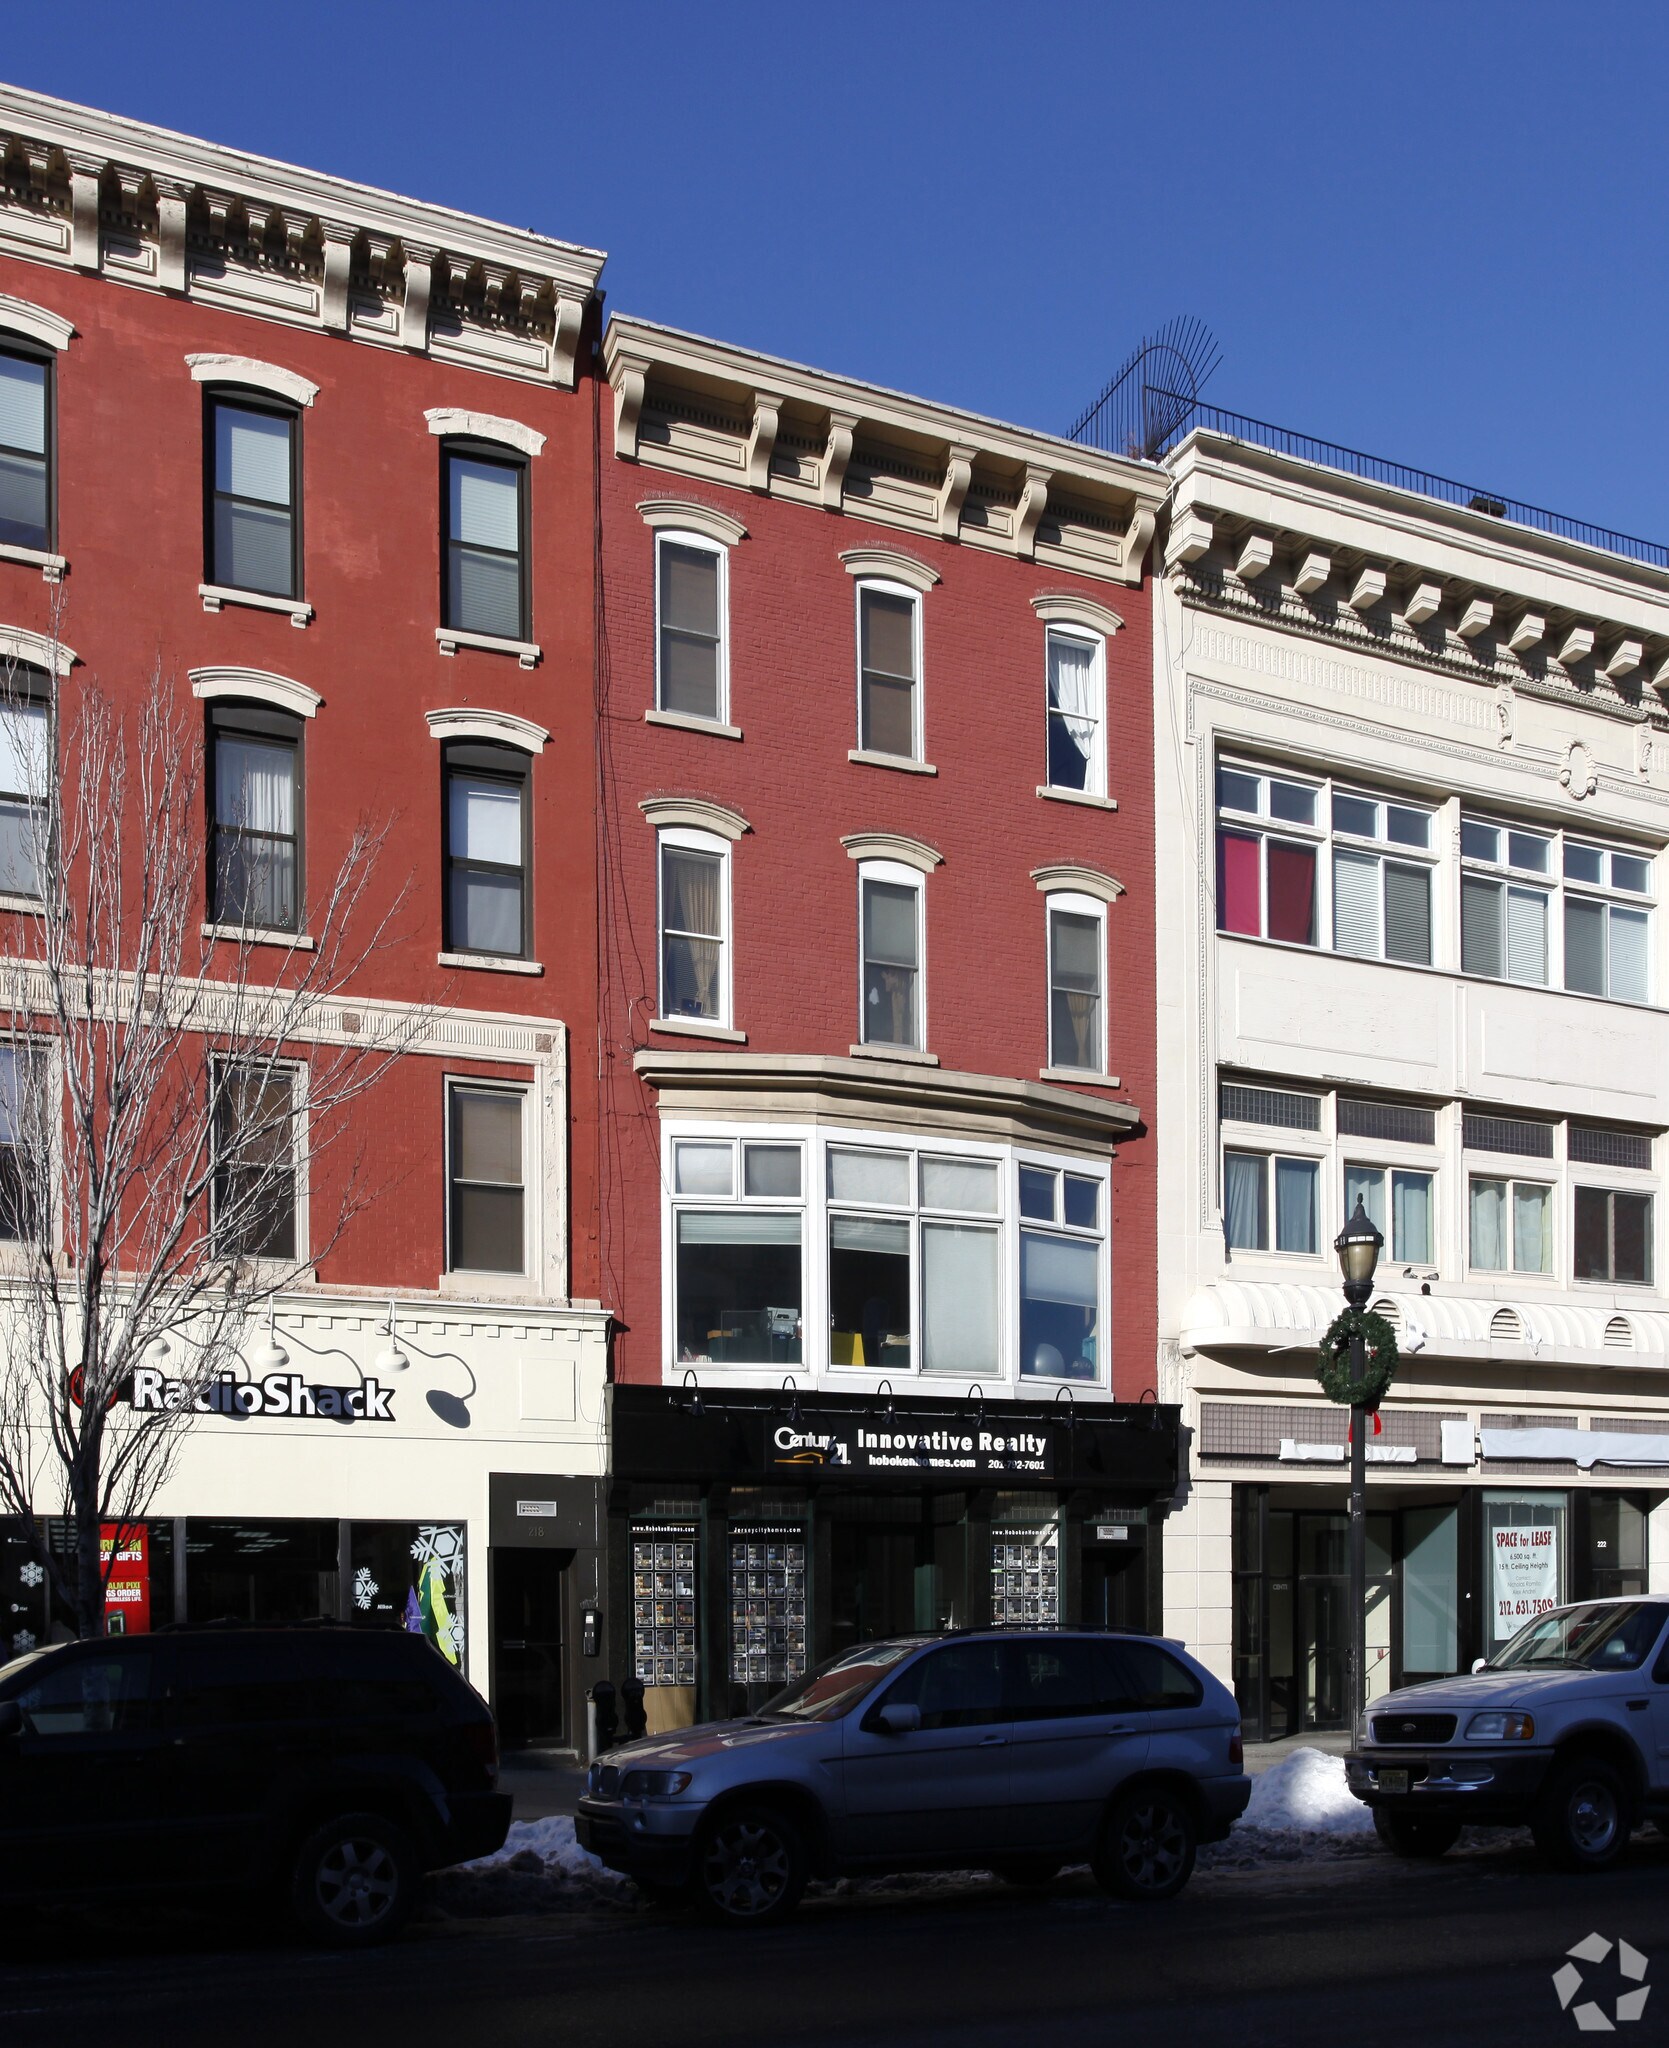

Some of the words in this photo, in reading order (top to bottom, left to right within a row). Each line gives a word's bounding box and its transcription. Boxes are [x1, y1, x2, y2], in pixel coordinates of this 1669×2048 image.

[134, 1368, 391, 1418] RadioShack
[773, 1426, 837, 1451] Century
[857, 1429, 973, 1451] Innovative
[979, 1432, 1047, 1456] Realty
[869, 1455, 976, 1469] hobokenhomes.com
[988, 1460, 1046, 1471] 201-792-7601
[1497, 1533, 1518, 1547] SPACE
[1521, 1534, 1529, 1547] for
[1532, 1531, 1552, 1546] LEASE
[117, 1552, 142, 1561] GIFTS
